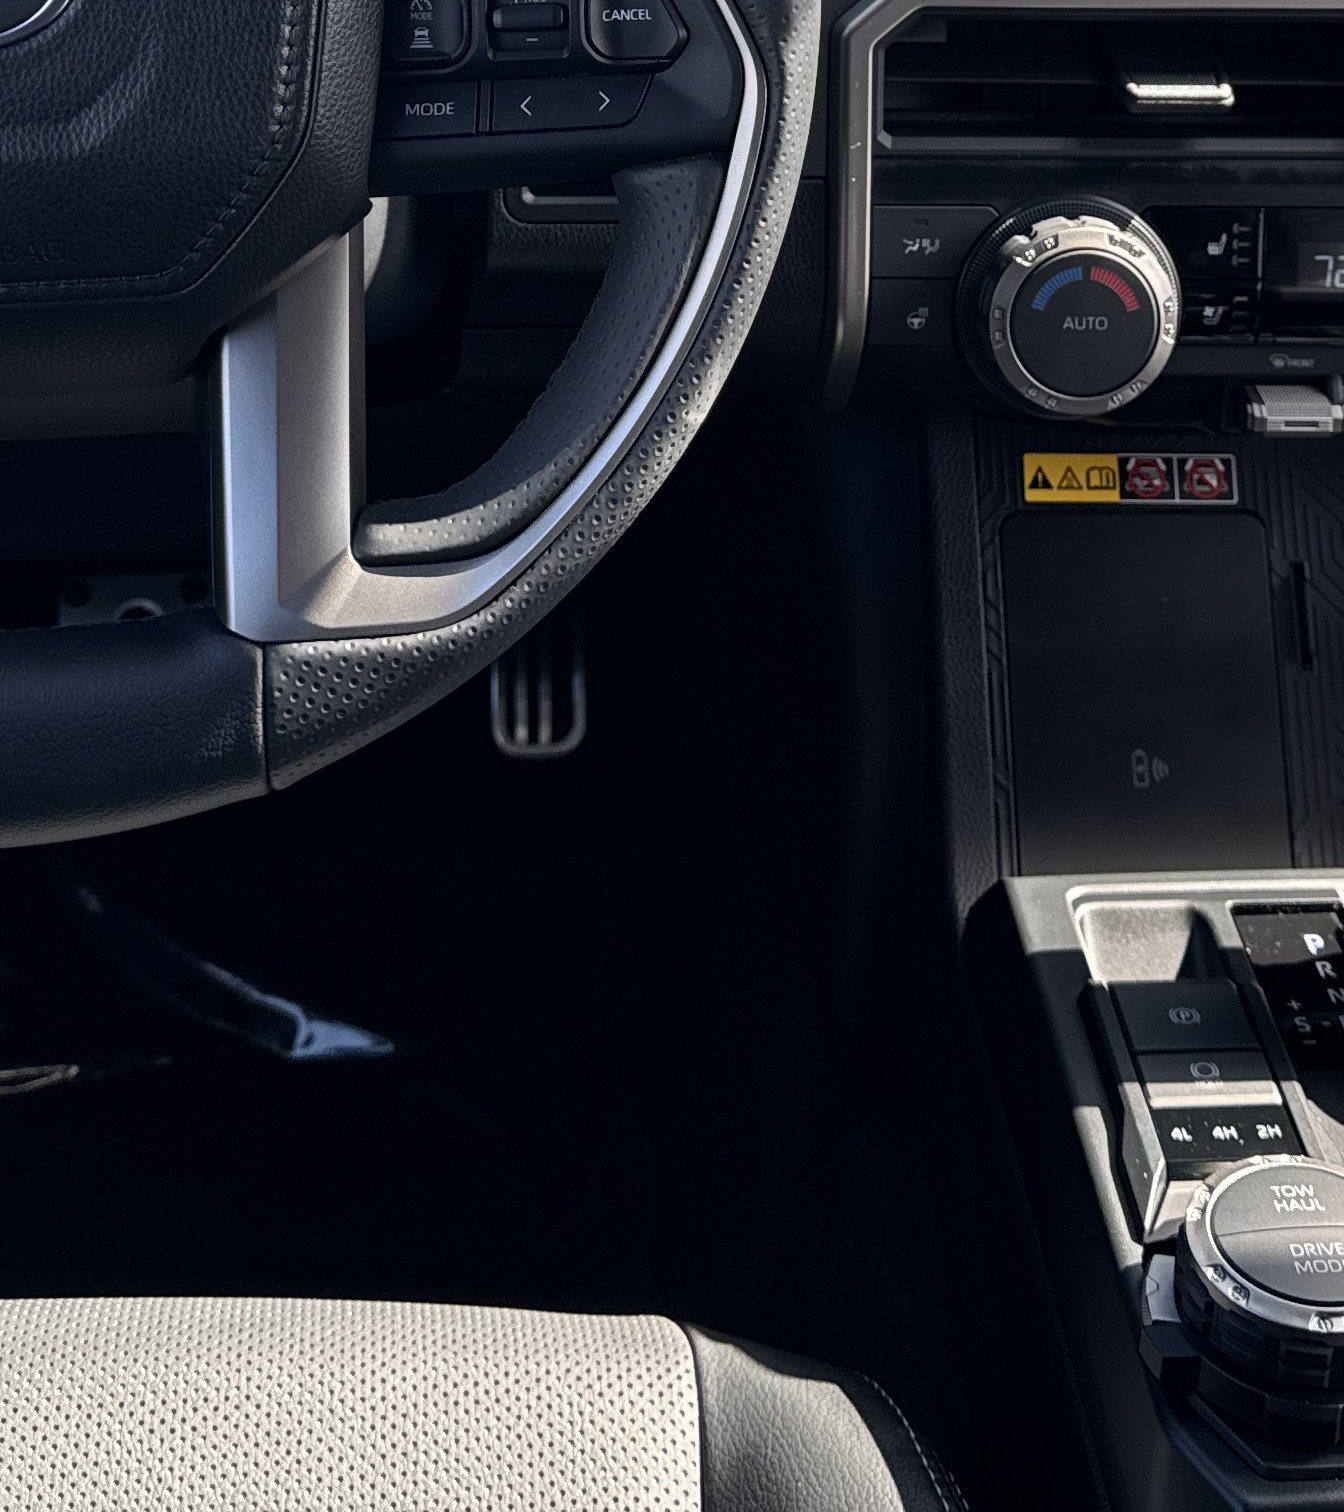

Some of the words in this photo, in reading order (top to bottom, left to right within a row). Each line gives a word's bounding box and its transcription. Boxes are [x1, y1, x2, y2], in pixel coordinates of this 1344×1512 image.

[410, 11, 433, 21] MODE
[602, 8, 653, 22] CANCEL
[405, 101, 455, 117] MODE
[1062, 316, 1109, 331] AUTO
[1288, 358, 1316, 368] FRONT
[1303, 933, 1325, 956] P
[1315, 960, 1338, 980] R
[1293, 1016, 1312, 1033] S
[1170, 1126, 1193, 1142] 4L
[1212, 1125, 1239, 1142] 4H
[1255, 1123, 1283, 1139] 2H
[1270, 1184, 1314, 1198] TOW
[1273, 1198, 1326, 1213] HAUL
